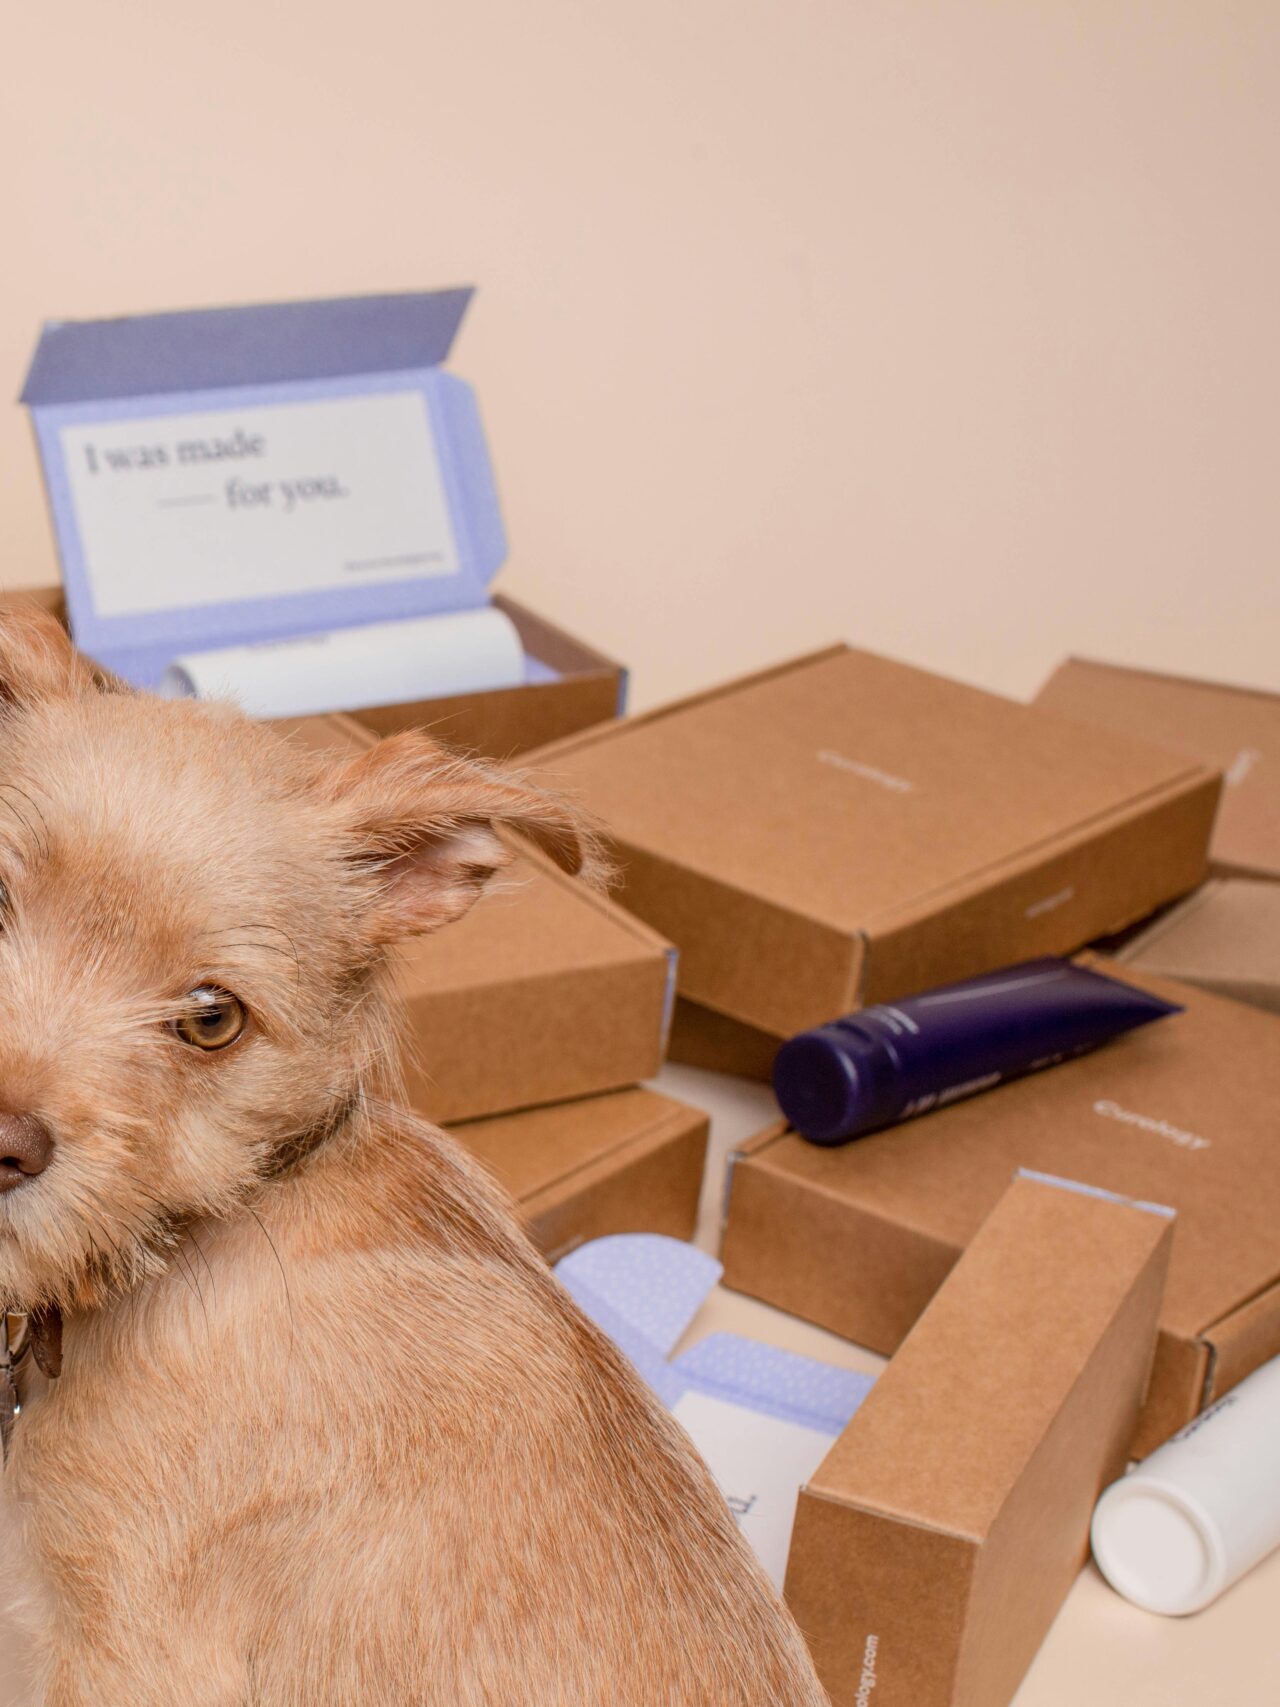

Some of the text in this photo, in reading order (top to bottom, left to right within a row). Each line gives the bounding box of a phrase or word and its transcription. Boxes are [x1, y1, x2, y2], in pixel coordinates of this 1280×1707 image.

[84, 428, 266, 476] I was made
[226, 476, 350, 513] for you.
[1092, 1099, 1212, 1151] Curology
